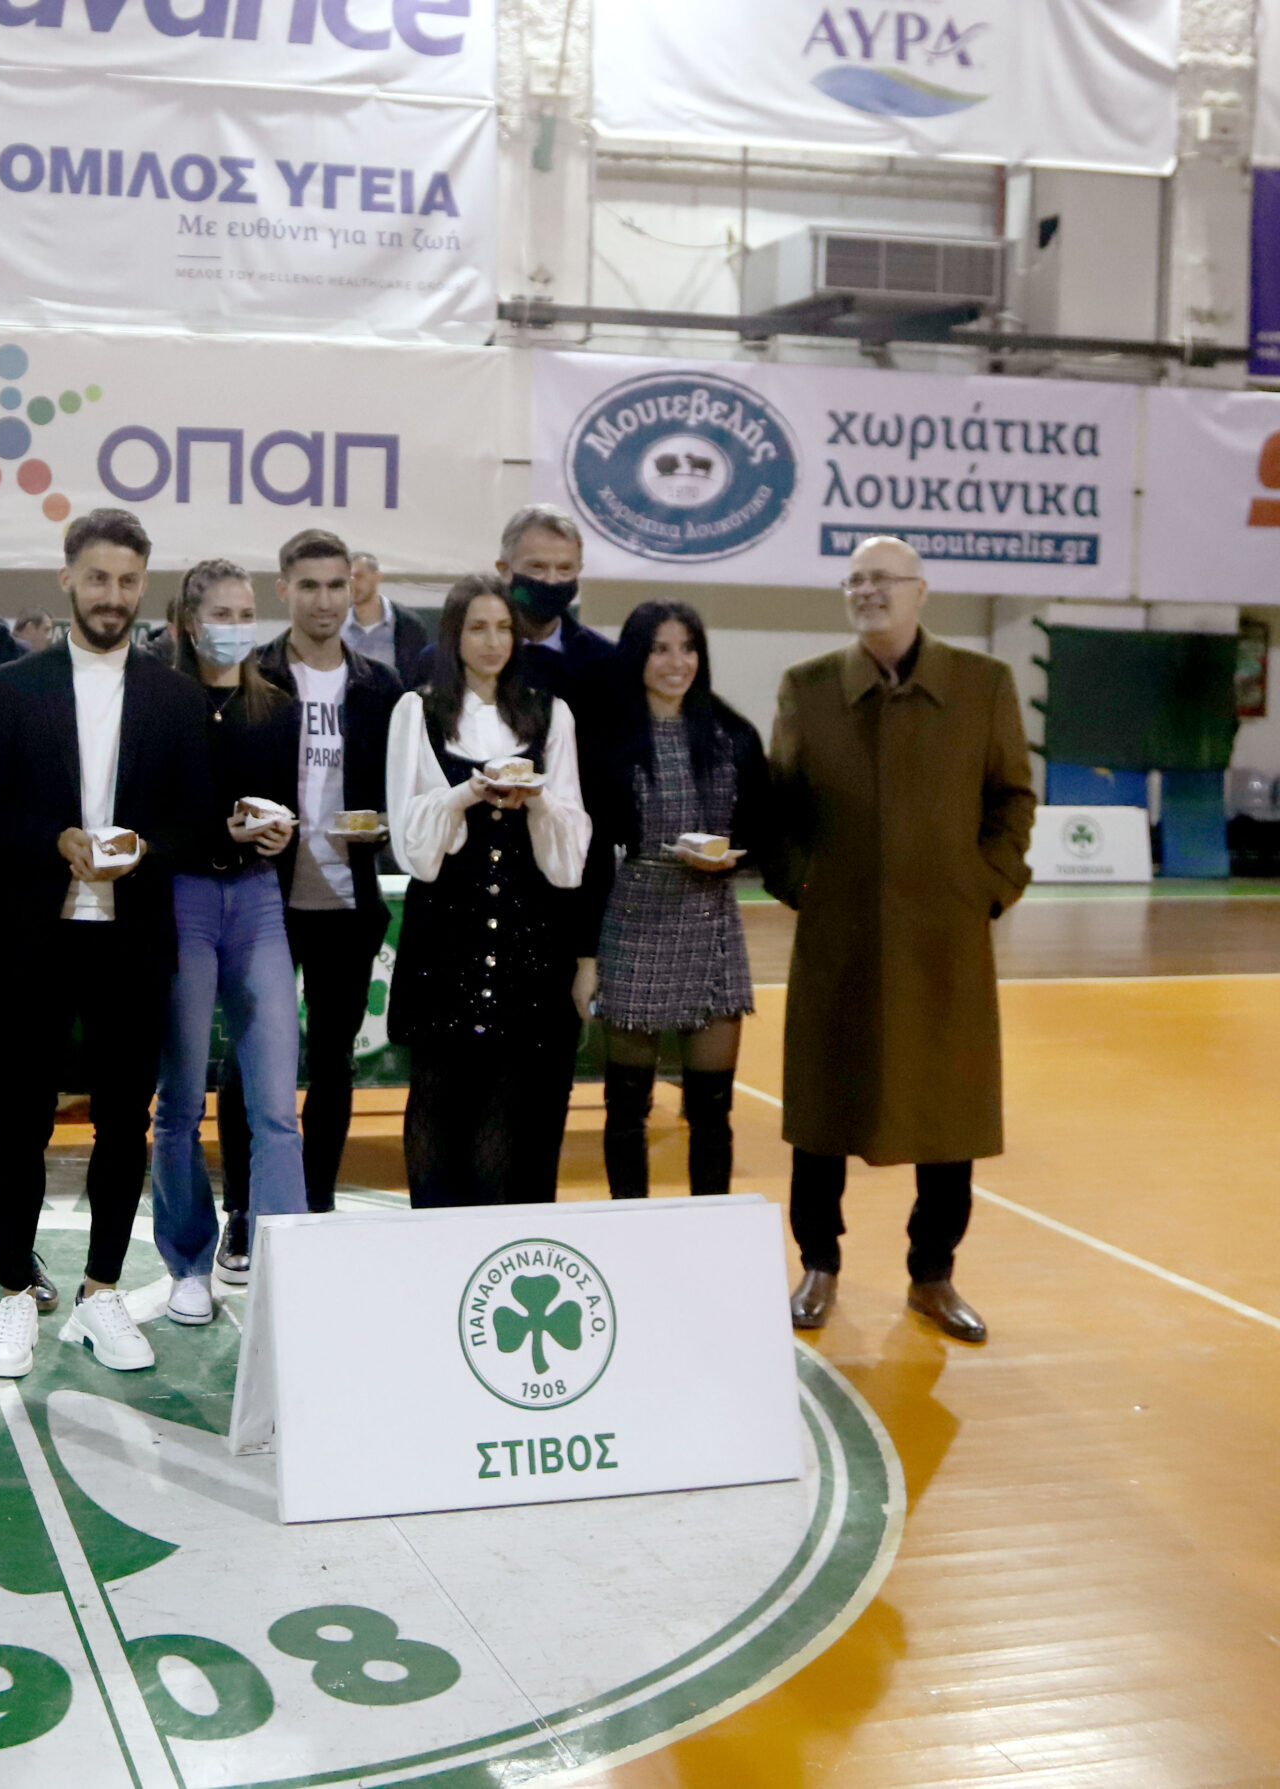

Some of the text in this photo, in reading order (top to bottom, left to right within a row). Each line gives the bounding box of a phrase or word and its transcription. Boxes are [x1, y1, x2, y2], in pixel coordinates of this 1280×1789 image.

[801, 8, 976, 66] ΑΥΡΑ
[276, 160, 461, 218] ΥΓΕΙΑ
[177, 214, 461, 252] Με ευθύνη για τη ζωή
[826, 402, 1100, 461] χωριάτικα
[824, 459, 1100, 517] λουκάνικα
[305, 748, 341, 768] PARIS
[522, 1380, 567, 1399] 1908
[477, 1433, 618, 1479] ΣΤΙΒΟΣ
